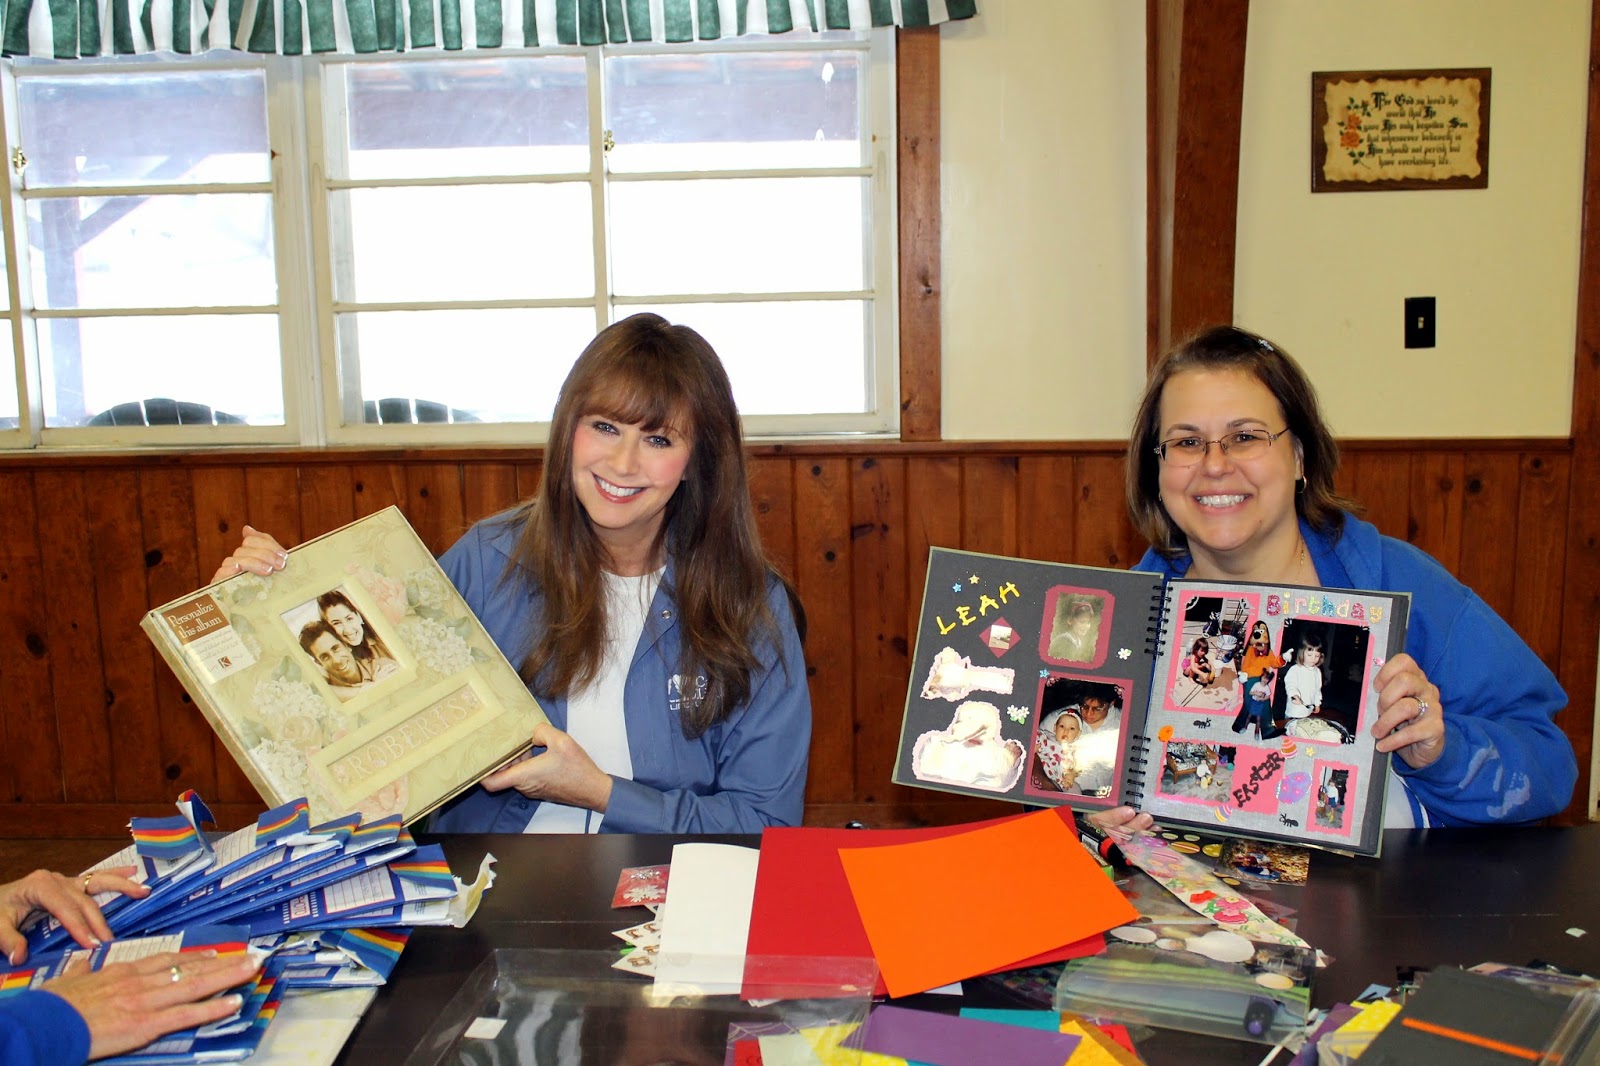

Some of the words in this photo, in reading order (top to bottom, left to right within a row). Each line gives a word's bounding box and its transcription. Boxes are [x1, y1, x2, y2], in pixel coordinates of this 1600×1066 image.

[167, 602, 215, 628] Personalize
[936, 581, 1020, 635] LEAH
[1266, 591, 1383, 624] Birthday
[178, 624, 198, 639] this
[196, 617, 222, 637] album
[349, 698, 468, 781] ROBERTS
